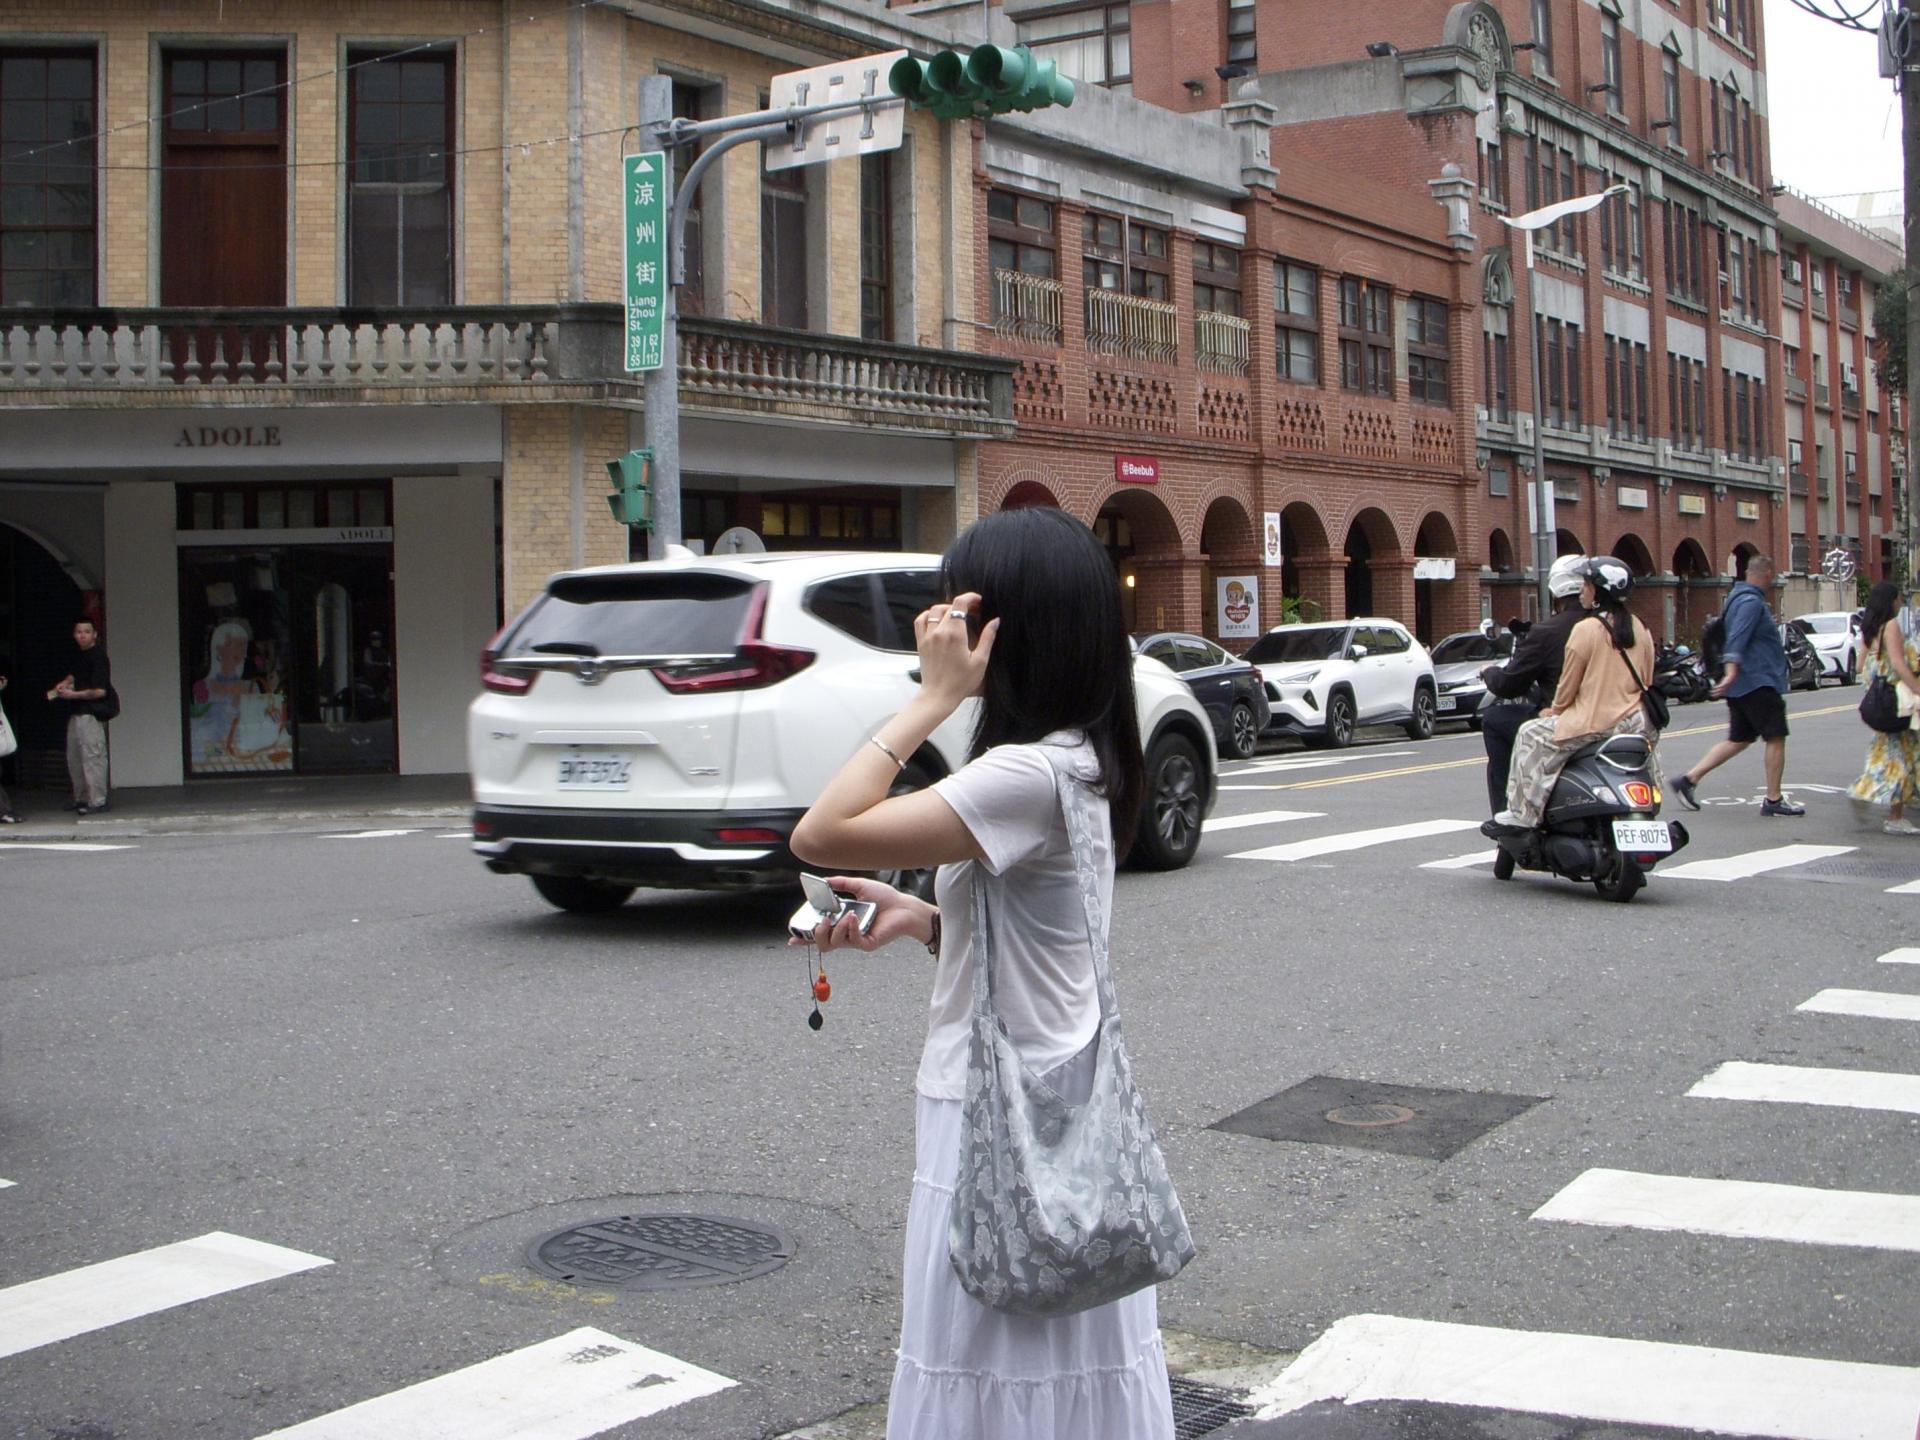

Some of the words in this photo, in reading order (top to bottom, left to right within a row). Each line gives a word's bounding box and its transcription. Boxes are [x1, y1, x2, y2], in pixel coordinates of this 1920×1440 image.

[634, 182, 657, 285] 涼州街
[629, 295, 657, 308] Liang
[630, 308, 656, 319] Zhou
[630, 320, 643, 331] St.
[646, 352, 659, 365] 112
[174, 426, 282, 447] ADOLE
[1129, 463, 1154, 477] Beebub
[336, 529, 388, 541] ADOLE
[1616, 829, 1668, 844] PEF-8075
